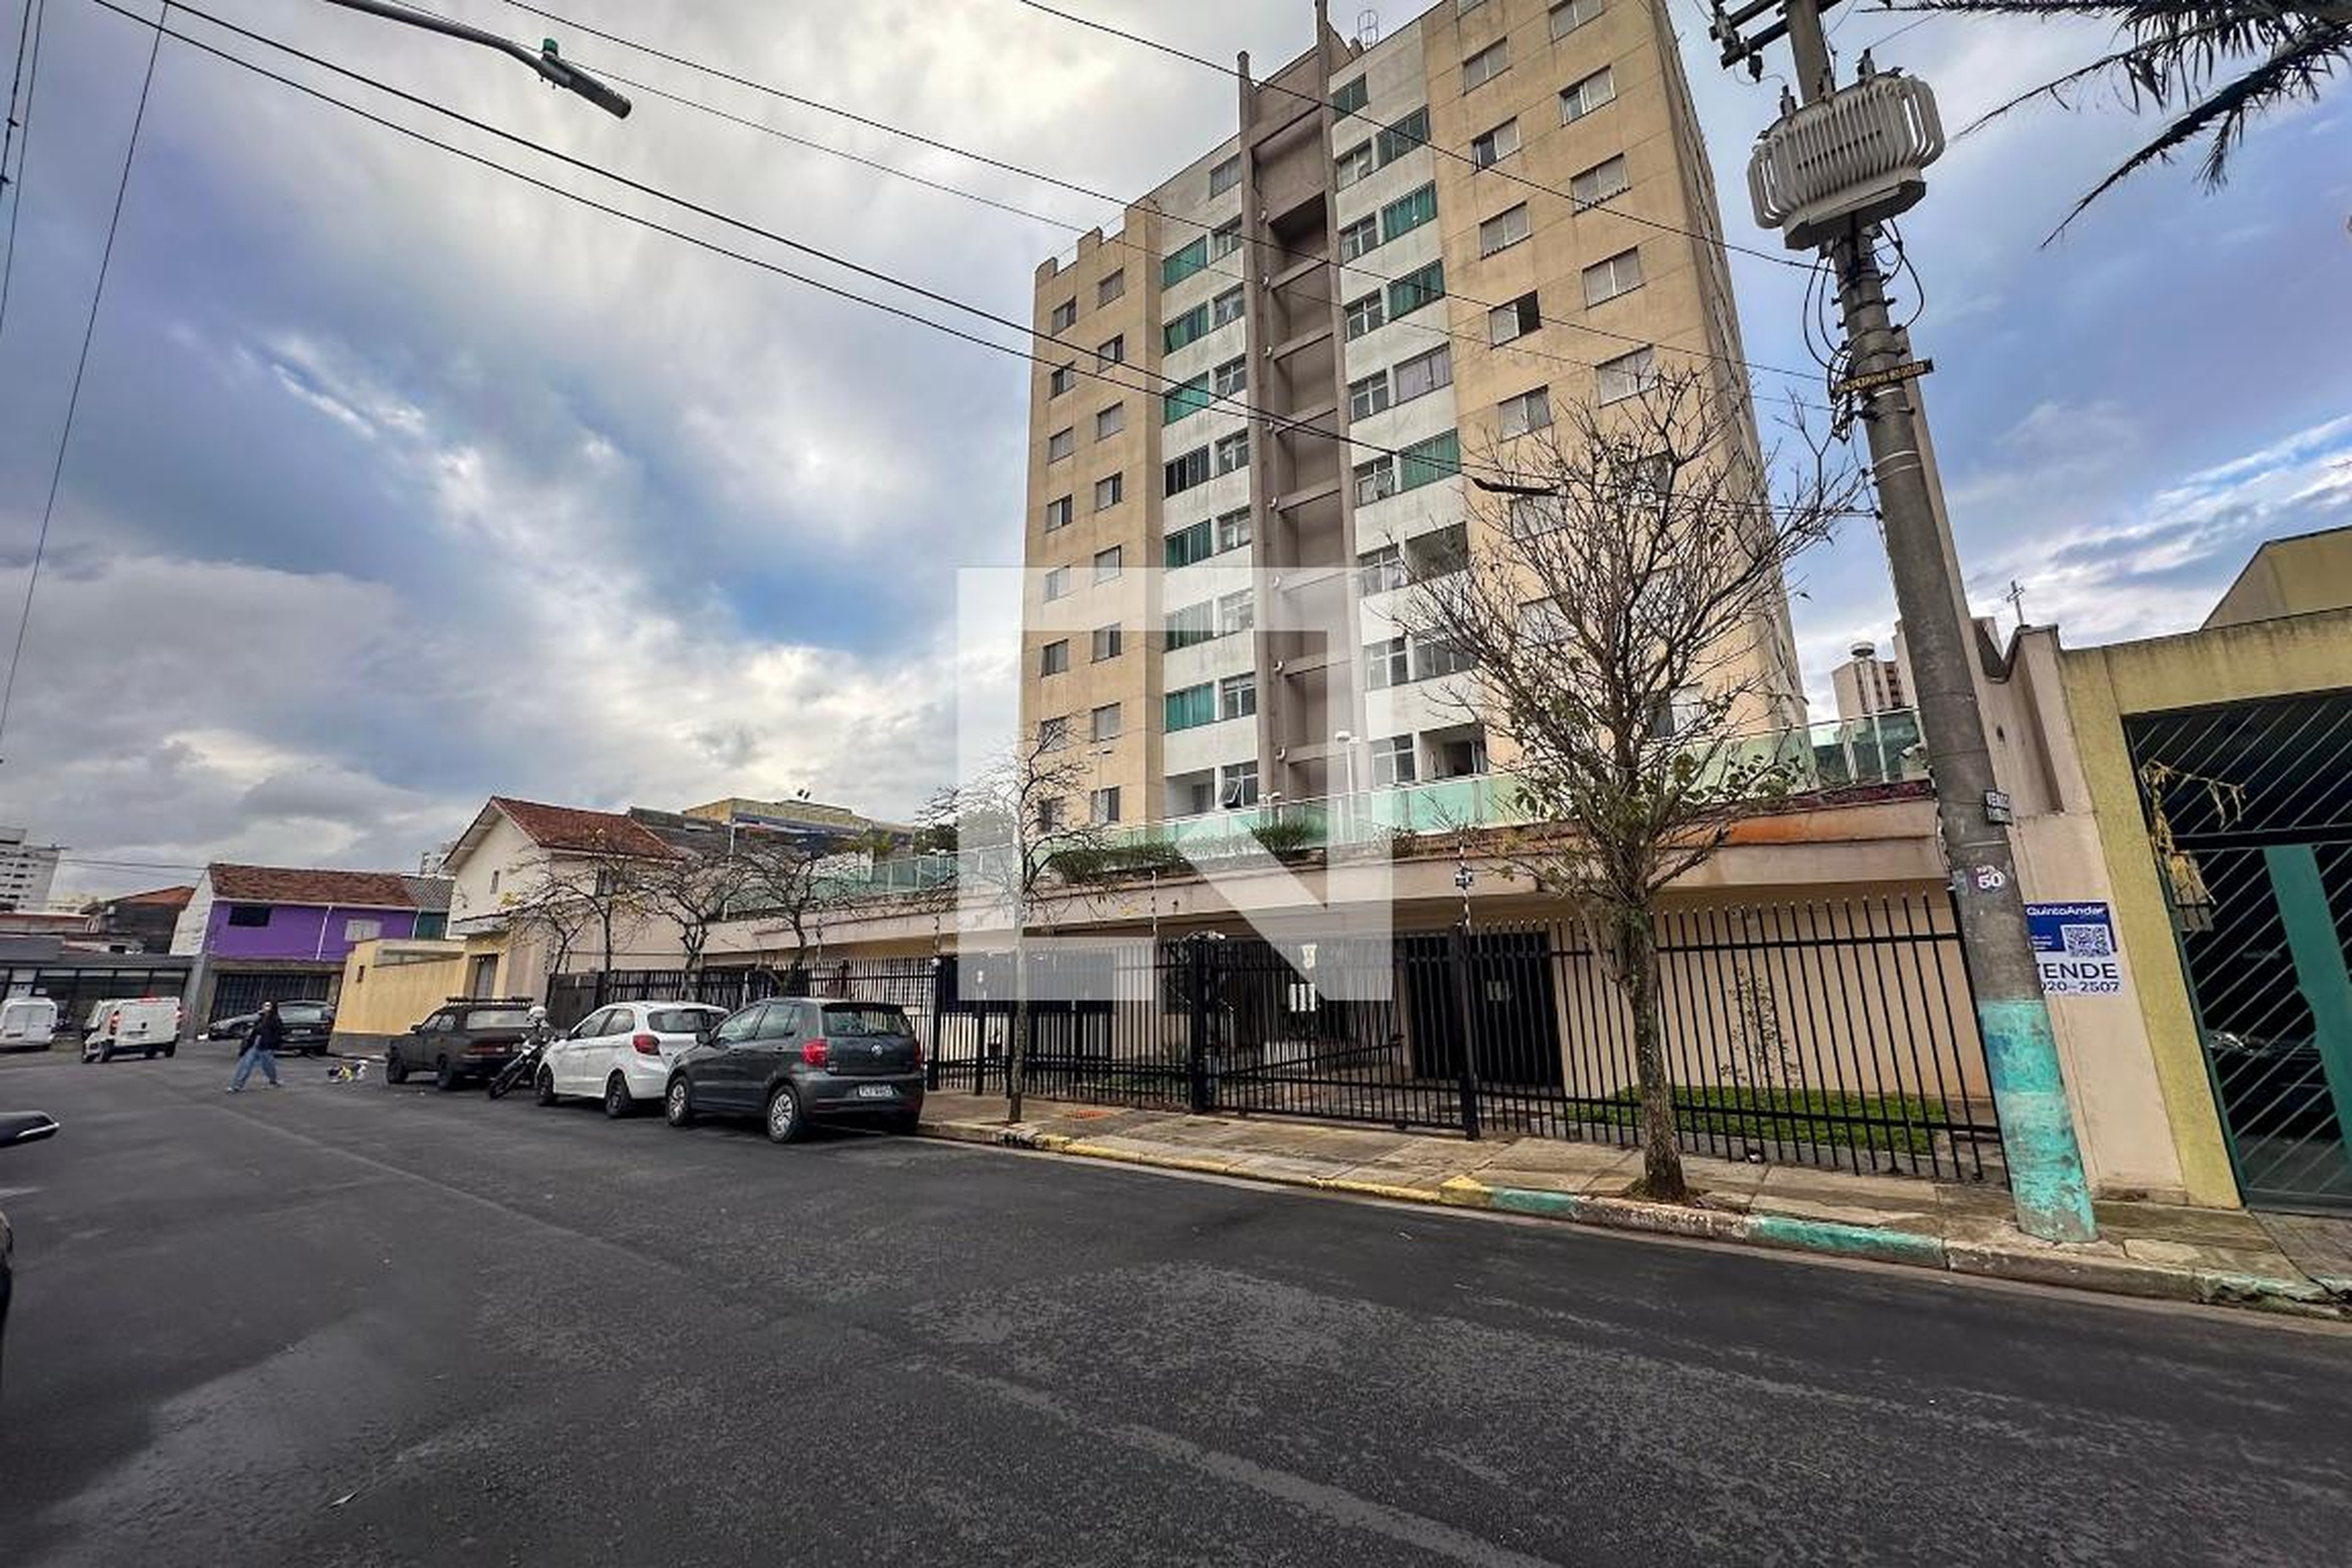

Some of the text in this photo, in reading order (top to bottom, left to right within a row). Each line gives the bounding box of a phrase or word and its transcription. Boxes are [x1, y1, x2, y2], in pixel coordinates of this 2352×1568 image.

[1978, 873, 2002, 888] 50
[2026, 906, 2105, 915] QuintoAndar
[2037, 963, 2117, 978] ENDE
